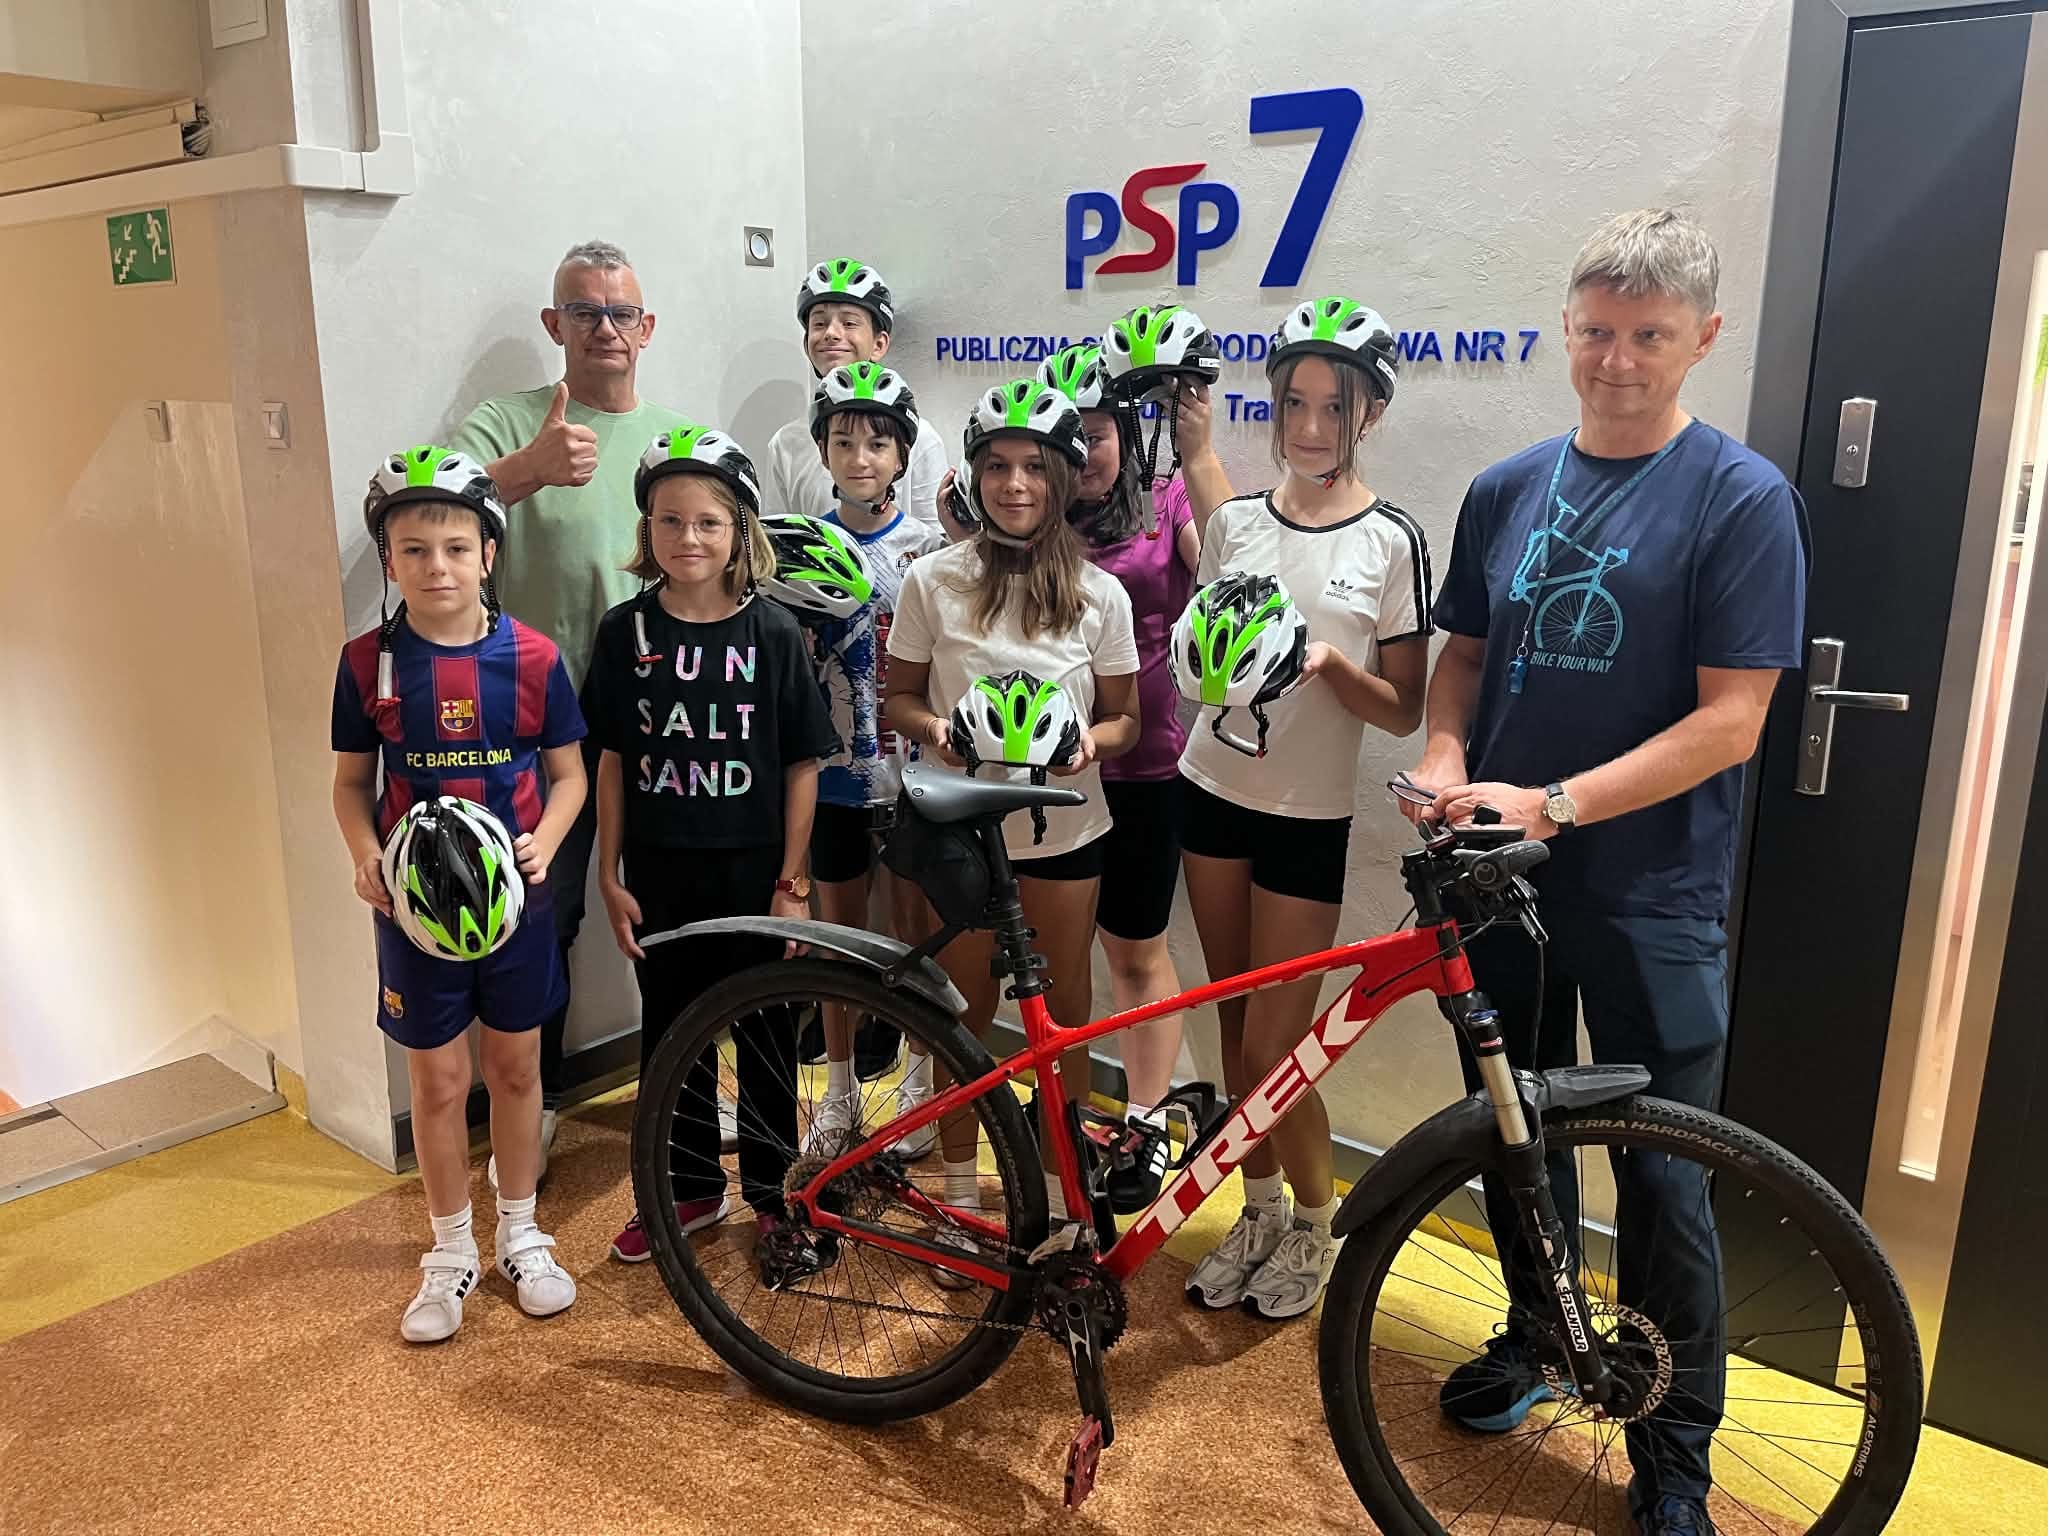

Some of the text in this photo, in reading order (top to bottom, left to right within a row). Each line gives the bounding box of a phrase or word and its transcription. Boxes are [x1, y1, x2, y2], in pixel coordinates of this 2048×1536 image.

[1250, 88, 1364, 287] 7
[1454, 331, 1505, 362] NR
[1518, 331, 1539, 362] 7
[1530, 651, 1613, 673] BIKE YOUR WAY
[637, 698, 755, 740] SALT
[406, 748, 512, 768] FC BARCELONA
[638, 754, 752, 797] SAND
[1136, 986, 1372, 1235] TREK
[1565, 1119, 1626, 1130] TERRA
[1631, 1120, 1740, 1157] HARDPACK
[1564, 1304, 1587, 1350] SUNTOUR
[1853, 1413, 1877, 1478] ALEXRIMS
